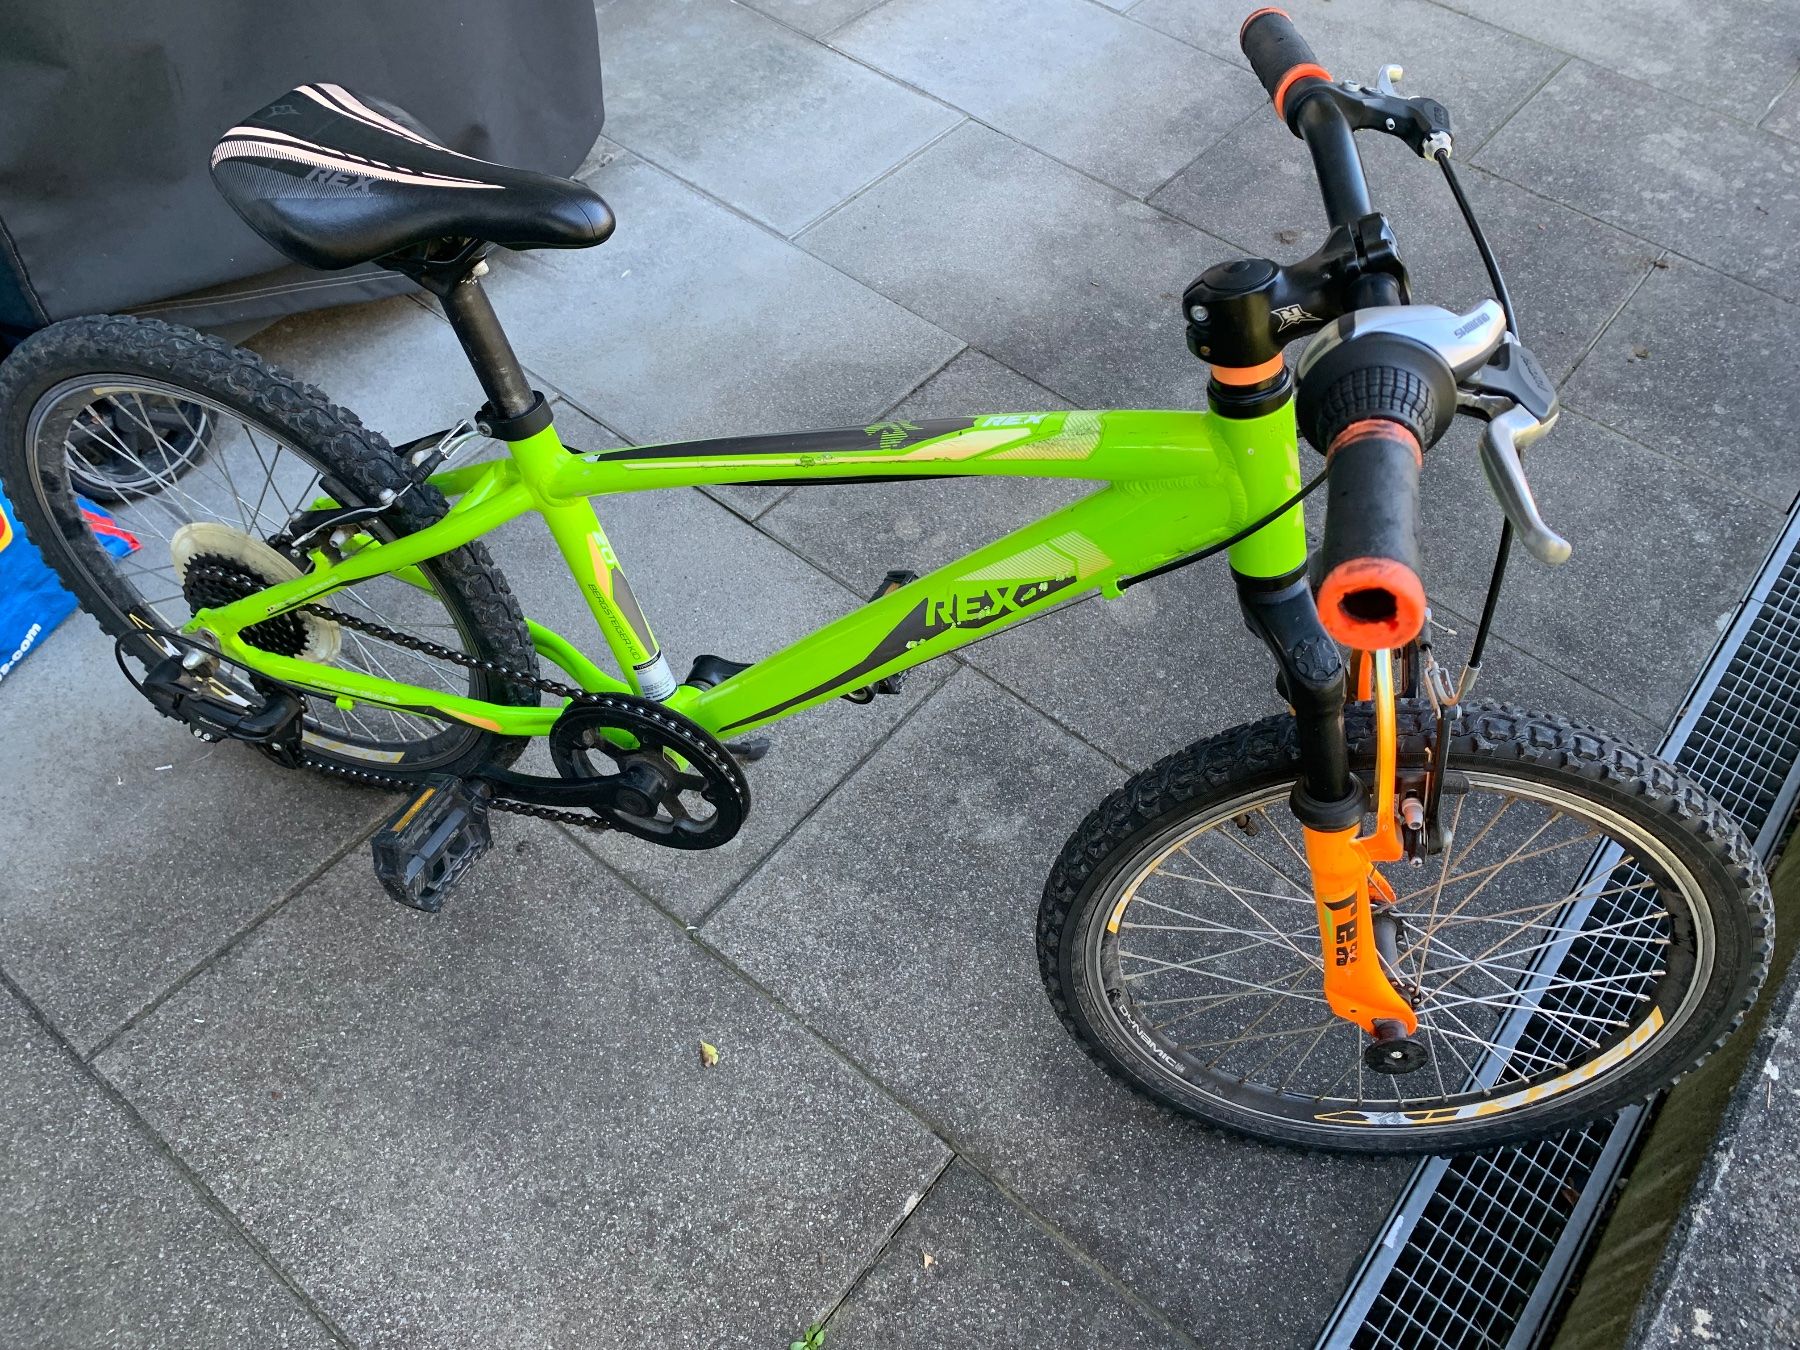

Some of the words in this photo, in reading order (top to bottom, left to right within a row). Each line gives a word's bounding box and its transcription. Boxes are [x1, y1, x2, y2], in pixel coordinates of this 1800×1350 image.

[304, 166, 380, 193] REX
[1454, 312, 1491, 339] SHIMANO
[982, 414, 1047, 427] REX
[588, 583, 631, 645] BERGSTEIGER
[926, 585, 1020, 627] REX
